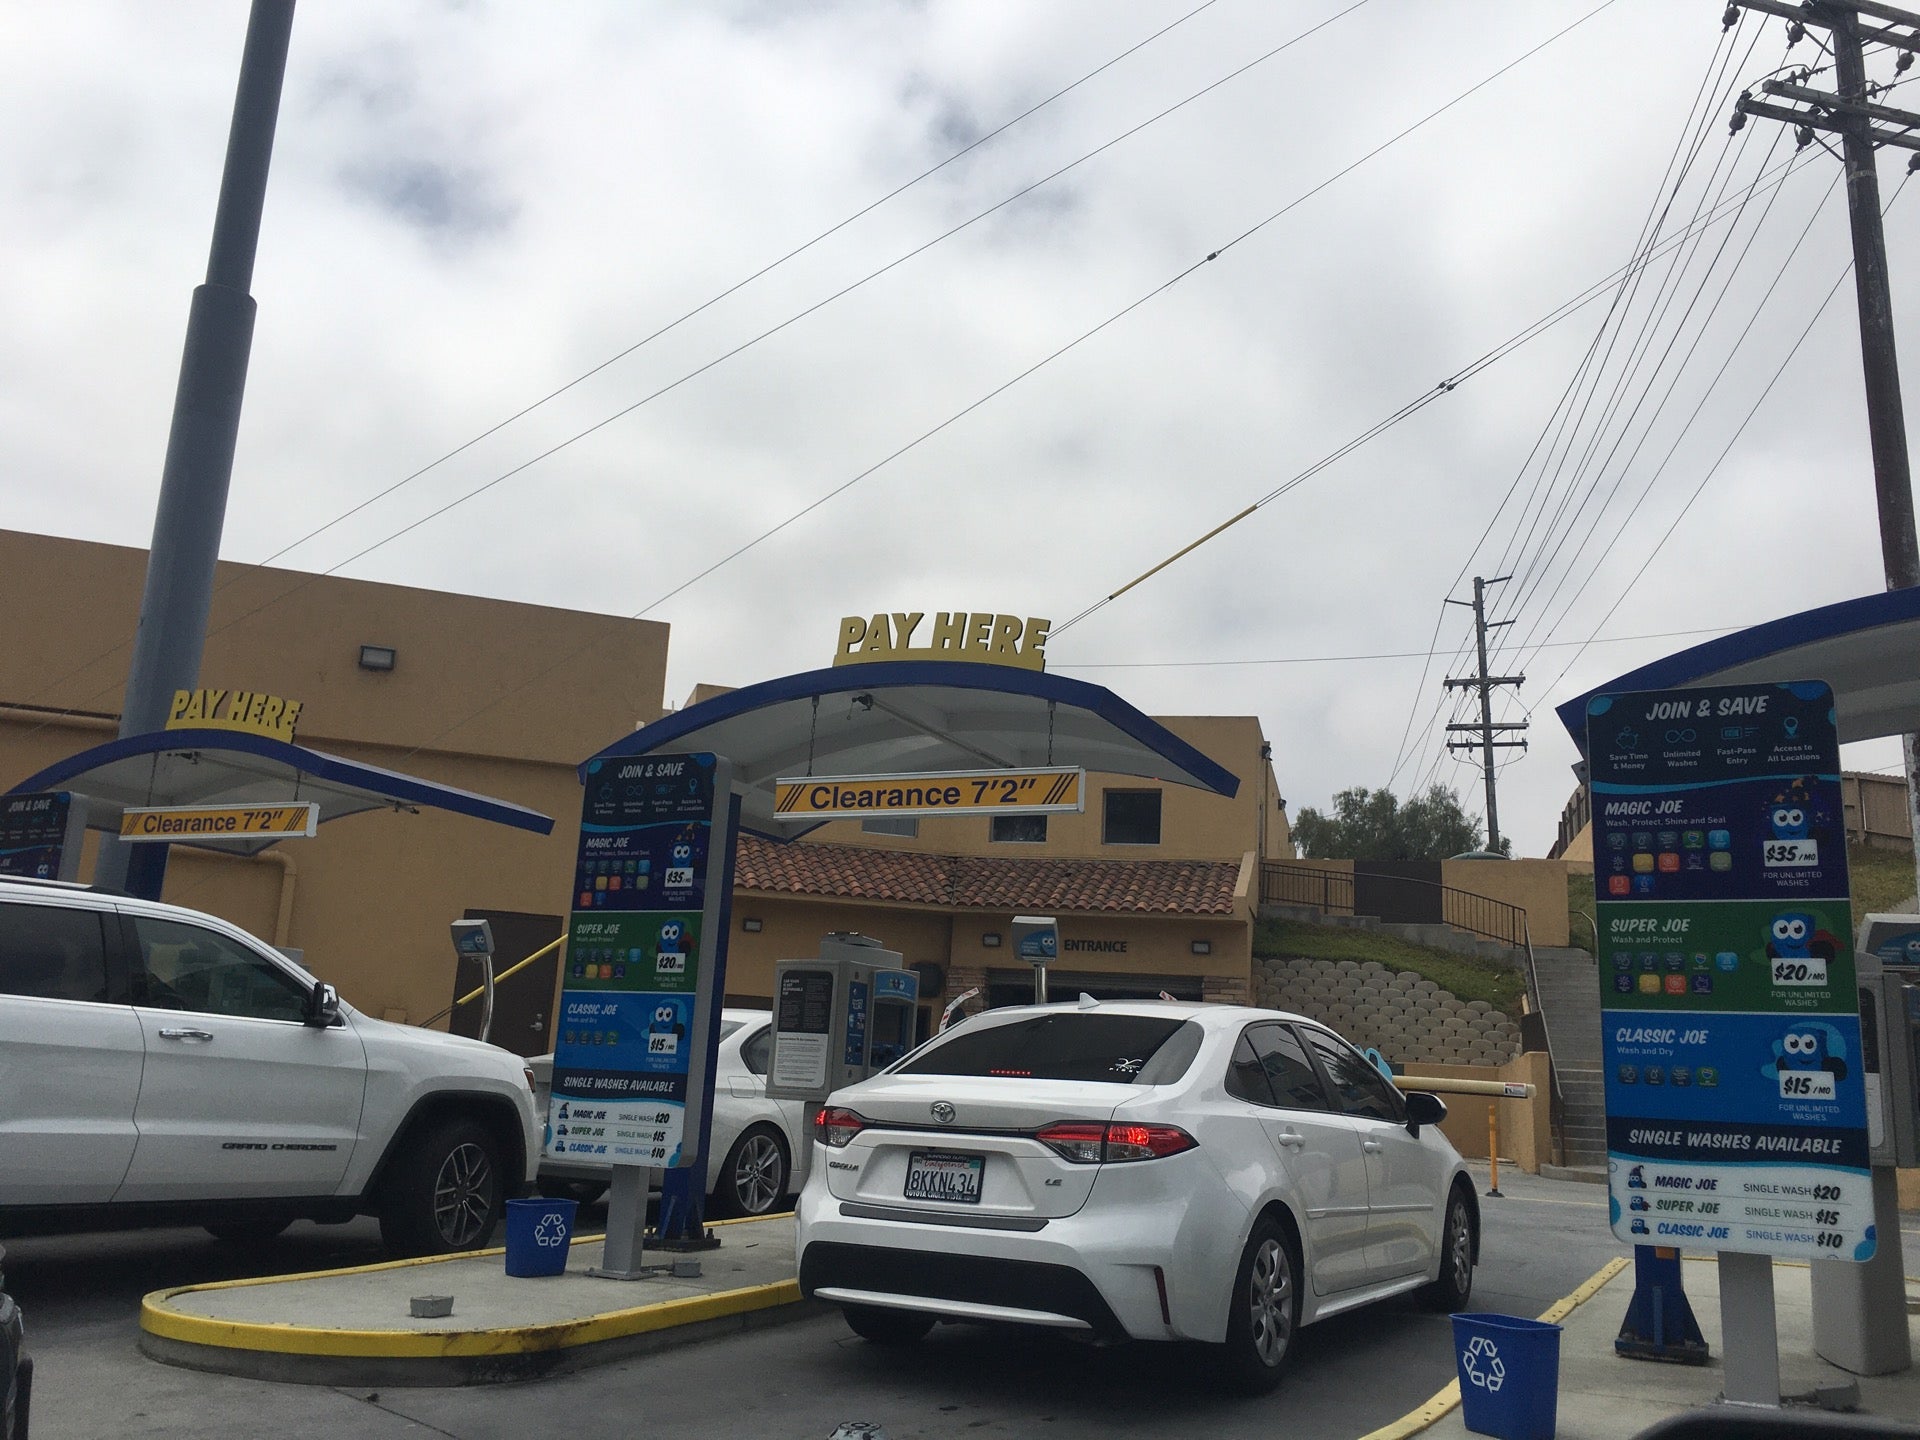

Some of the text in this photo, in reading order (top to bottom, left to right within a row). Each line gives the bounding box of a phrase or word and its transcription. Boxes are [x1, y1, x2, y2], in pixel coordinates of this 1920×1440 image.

[837, 612, 1052, 659] PAY HERE
[167, 689, 303, 732] PAY HERE
[1646, 696, 1770, 720] JOIN & SAVE
[1663, 750, 1701, 759] Unlimited
[1717, 747, 1757, 756] Fast-Pass
[1773, 744, 1813, 753] Access to
[1609, 752, 1649, 761] Save Time
[1667, 759, 1698, 767] Washes
[1727, 757, 1748, 765] Entry
[1781, 752, 1821, 761] Locations
[618, 762, 686, 779] JOIN & SAVE
[1621, 762, 1646, 771] Money
[810, 783, 960, 809] Clearance
[1605, 800, 1683, 816] MAGIC JOE
[143, 814, 236, 833] Clearance
[1665, 817, 1688, 825] Shine
[1690, 816, 1705, 824] and
[1708, 816, 1726, 824] Seal
[586, 837, 631, 848] MAGIC JOE
[1766, 845, 1799, 863] $35
[667, 871, 684, 884] $35
[1763, 871, 1823, 880] FOR UNLIMITED
[1776, 879, 1810, 887] WASHES
[577, 924, 621, 934] SUPER JOE
[1610, 917, 1691, 932] SUPER JOE
[1064, 939, 1128, 953] ENTRANCE
[1611, 935, 1683, 944] Wash and Protect
[658, 956, 676, 969] $20
[1774, 963, 1807, 981] $20
[1771, 990, 1831, 999] FOR UNLIMITED
[568, 1003, 618, 1015] CLASSIC JOE
[1784, 999, 1818, 1007] WASHES
[1616, 1028, 1709, 1044] CLASSIC JOE
[650, 1038, 664, 1051] $15
[1617, 1047, 1674, 1056] Wash and Dry
[563, 1076, 675, 1093] SINGLE WASHES AVAILABLE
[1783, 1076, 1812, 1095] $15
[1779, 1104, 1840, 1113] FOR UNLIMITED
[572, 1109, 593, 1119] MAGIC
[594, 1110, 607, 1120] JOE
[618, 1113, 638, 1121] SINGLE
[654, 1112, 670, 1124] $20
[1792, 1113, 1826, 1121] WASHES
[571, 1126, 592, 1136] SUPER
[592, 1127, 605, 1137] JOE
[652, 1130, 666, 1142] $15
[1628, 1129, 1842, 1154] SINGLE WASHES AVAILABLE
[568, 1142, 594, 1153] CLASSIC
[594, 1144, 607, 1154] JOE
[651, 1147, 665, 1159] $10
[911, 1169, 975, 1193] 8KKN434
[1044, 1178, 1063, 1187] LE
[906, 1190, 927, 1198] TOYOTA
[1654, 1175, 1841, 1201] MAGIC JOE SINGLE WASH $20
[1656, 1199, 1840, 1225] SUPER JOE SINGLE WASH $15
[1657, 1222, 1843, 1249] CLASSIC JOE SINGLE WASH $10
